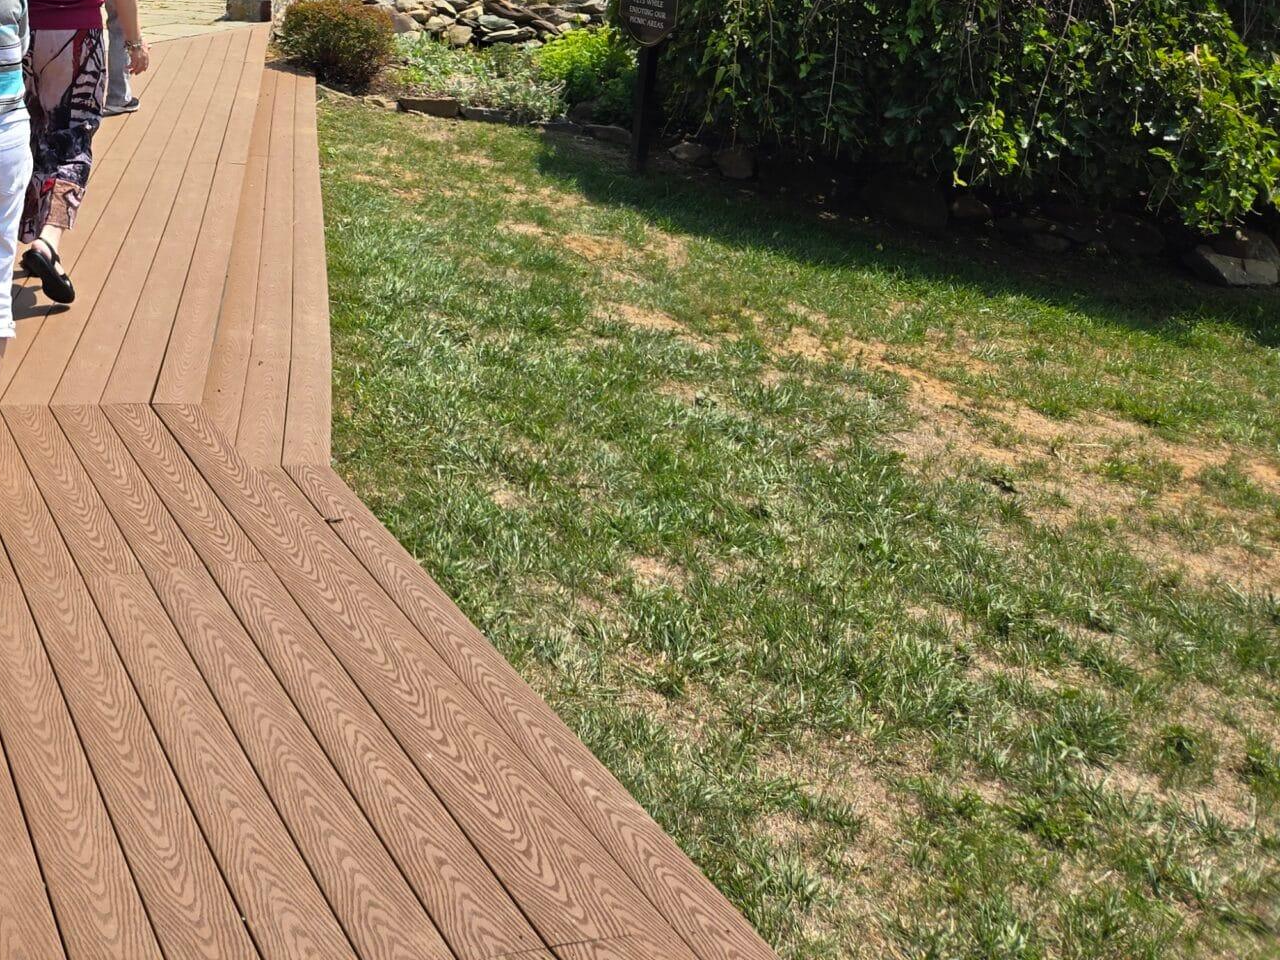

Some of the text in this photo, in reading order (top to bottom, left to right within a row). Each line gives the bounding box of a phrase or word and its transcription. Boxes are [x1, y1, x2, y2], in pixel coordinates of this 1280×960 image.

[629, 5, 666, 19] ENJOYING OUR
[630, 16, 664, 29] PICNIC AREAS
